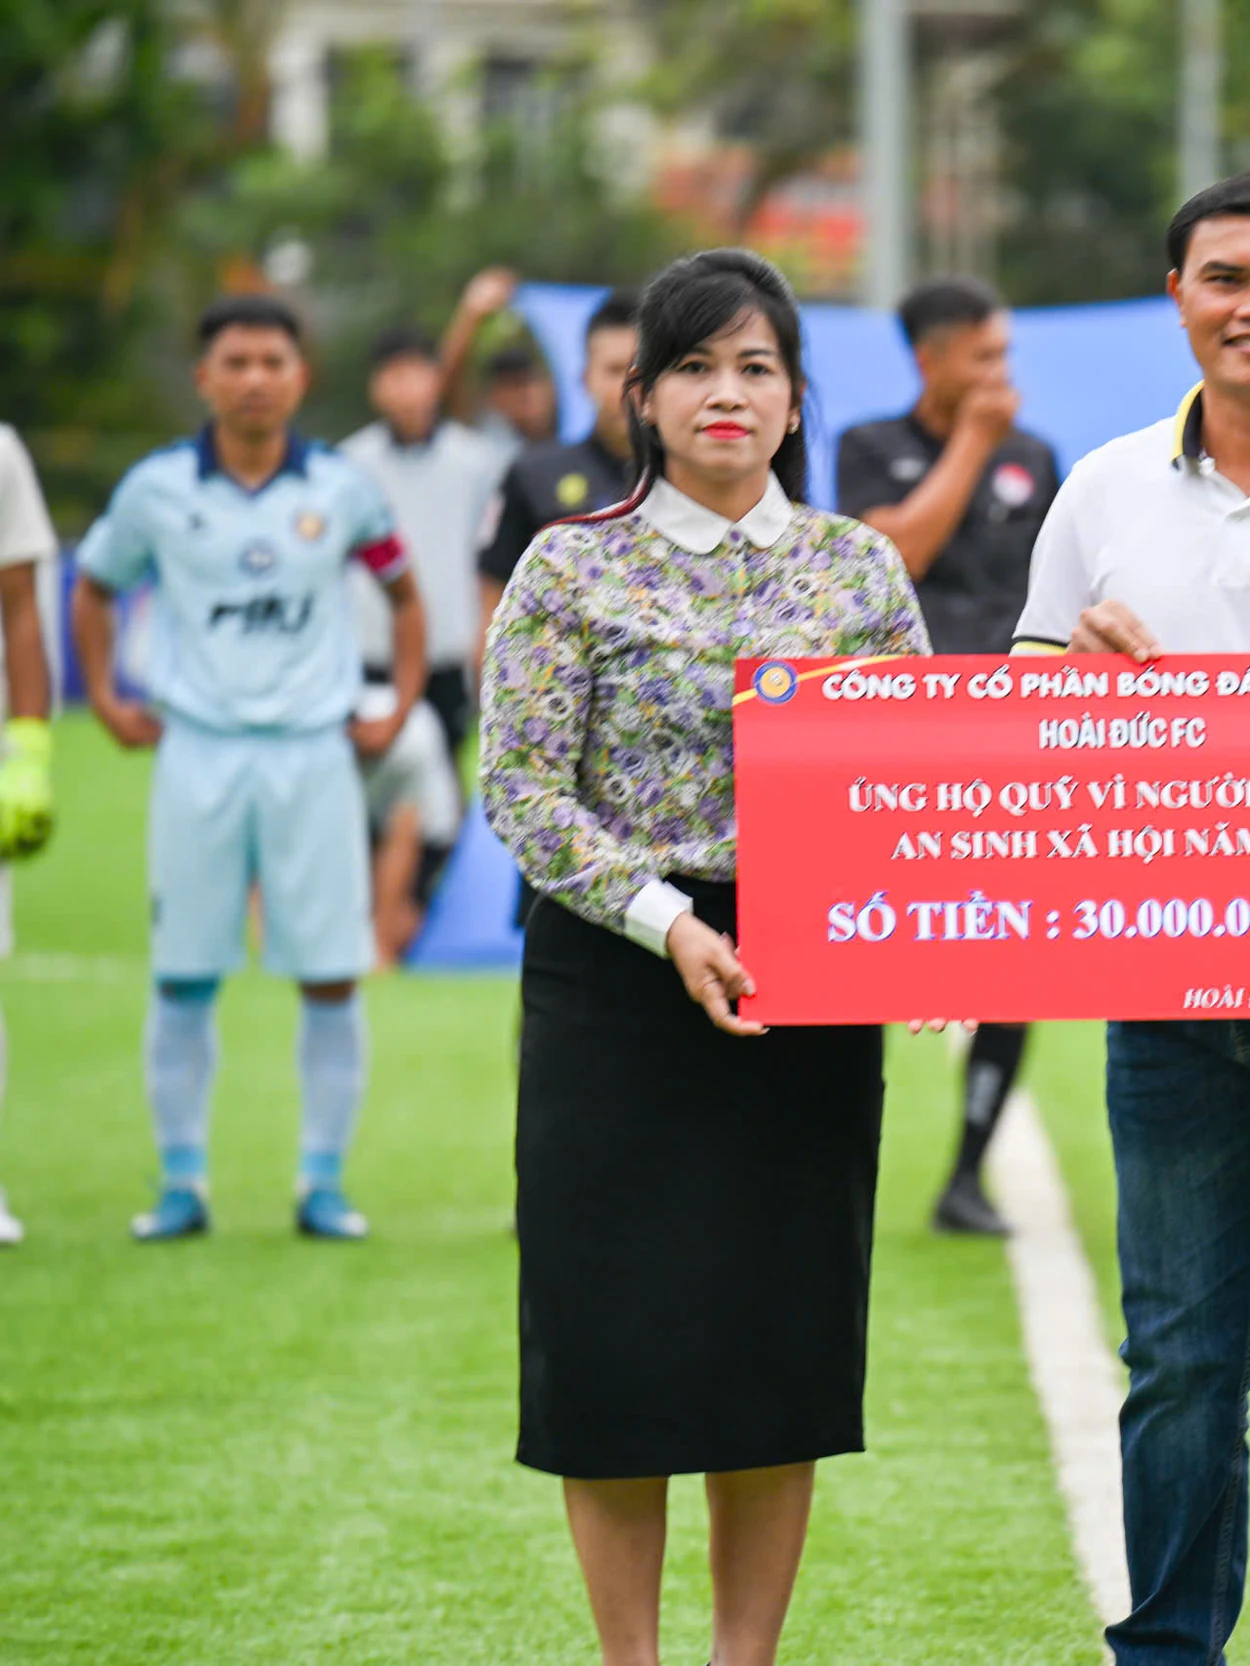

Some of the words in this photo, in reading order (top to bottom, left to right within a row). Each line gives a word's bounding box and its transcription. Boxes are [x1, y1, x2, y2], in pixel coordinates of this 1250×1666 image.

[822, 669, 916, 700] CÔNG
[922, 672, 961, 699] TY
[968, 665, 1013, 699] CỔ
[1021, 664, 1109, 698] PHẦN
[1117, 666, 1210, 697] BÓNG
[1039, 712, 1105, 749] HOÀI
[1109, 711, 1167, 748] ĐỨC
[1171, 717, 1207, 747] FC
[936, 778, 993, 818] HỘ
[999, 775, 1079, 816] QUỸ
[1086, 773, 1126, 809] VÌ
[890, 831, 943, 860] AN
[950, 831, 1038, 860] SINH
[1046, 823, 1099, 859] XÃ
[1107, 825, 1175, 864] HỘI
[827, 891, 897, 942] SỐ
[906, 889, 1033, 941] TIỀN
[1046, 910, 1060, 940] :
[1183, 984, 1244, 1009] HOÀI
